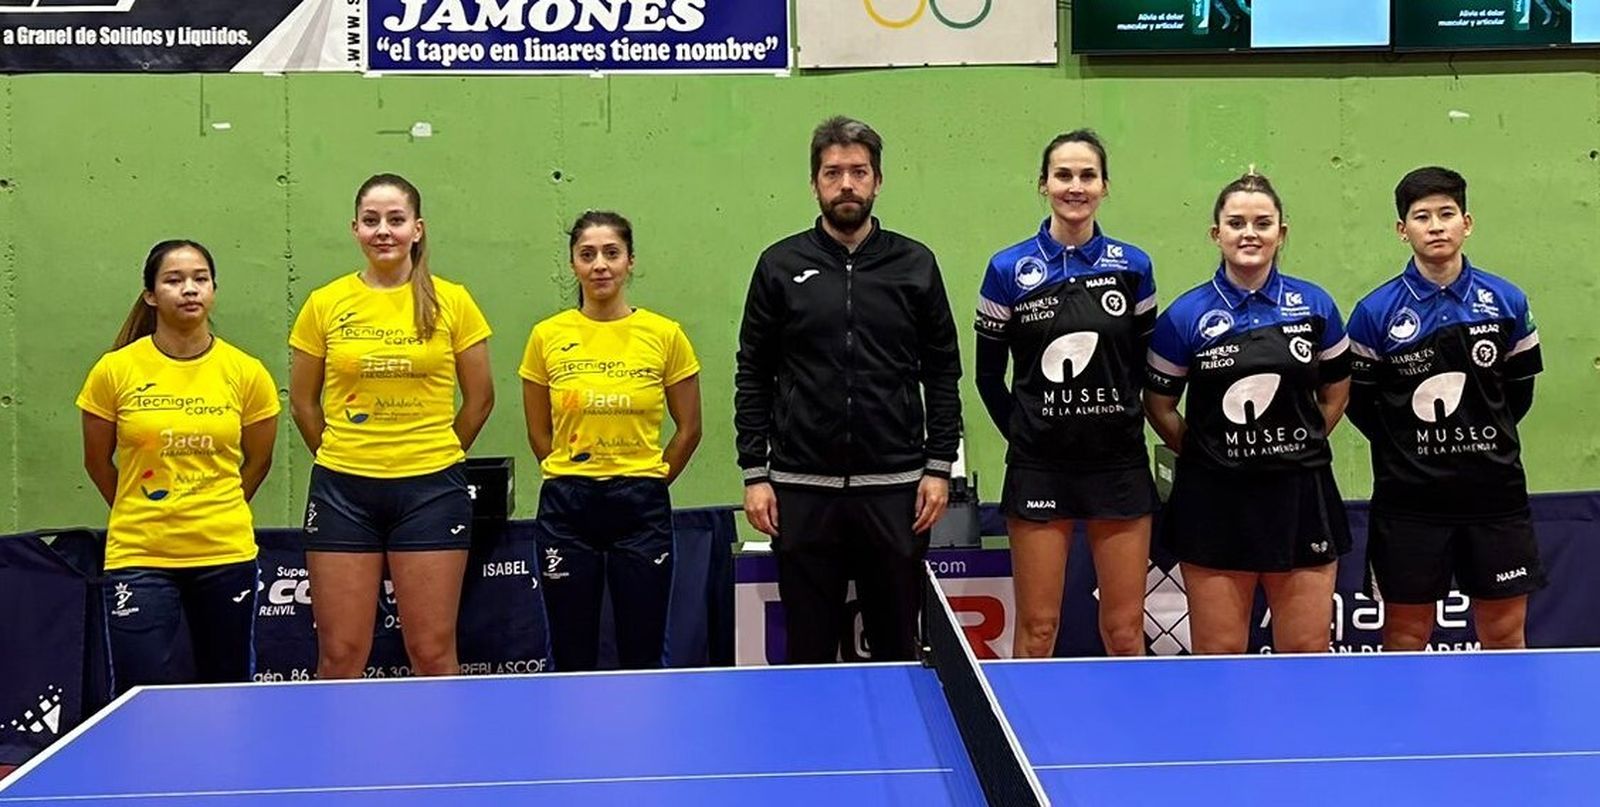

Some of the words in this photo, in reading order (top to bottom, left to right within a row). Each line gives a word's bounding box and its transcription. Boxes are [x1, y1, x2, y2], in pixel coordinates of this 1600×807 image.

[383, 0, 706, 32] JAMONES
[3, 29, 14, 45] a
[17, 26, 72, 45] Granel
[75, 26, 97, 45] de
[100, 26, 163, 45] Solidos
[165, 30, 176, 47] y
[178, 26, 252, 47] Liquidos.
[416, 39, 485, 67] tapeo
[489, 43, 519, 61] en
[523, 37, 606, 61] linares
[610, 37, 670, 61] tiene
[134, 395, 205, 410] Tecnigen
[1044, 388, 1119, 404] MUSEO
[1042, 407, 1054, 416] DE
[1059, 407, 1071, 416] LA
[1226, 427, 1307, 445] MUSEO
[1417, 426, 1497, 443] MUSEO
[1228, 448, 1239, 457] DE
[1244, 448, 1256, 457] LA
[1261, 443, 1306, 455] ALMENDRA
[1418, 446, 1428, 455] DE
[1434, 446, 1446, 455] LA
[1451, 443, 1498, 454] ALMENDRA
[483, 560, 529, 577] ISABEL
[258, 605, 296, 616] RENVIL
